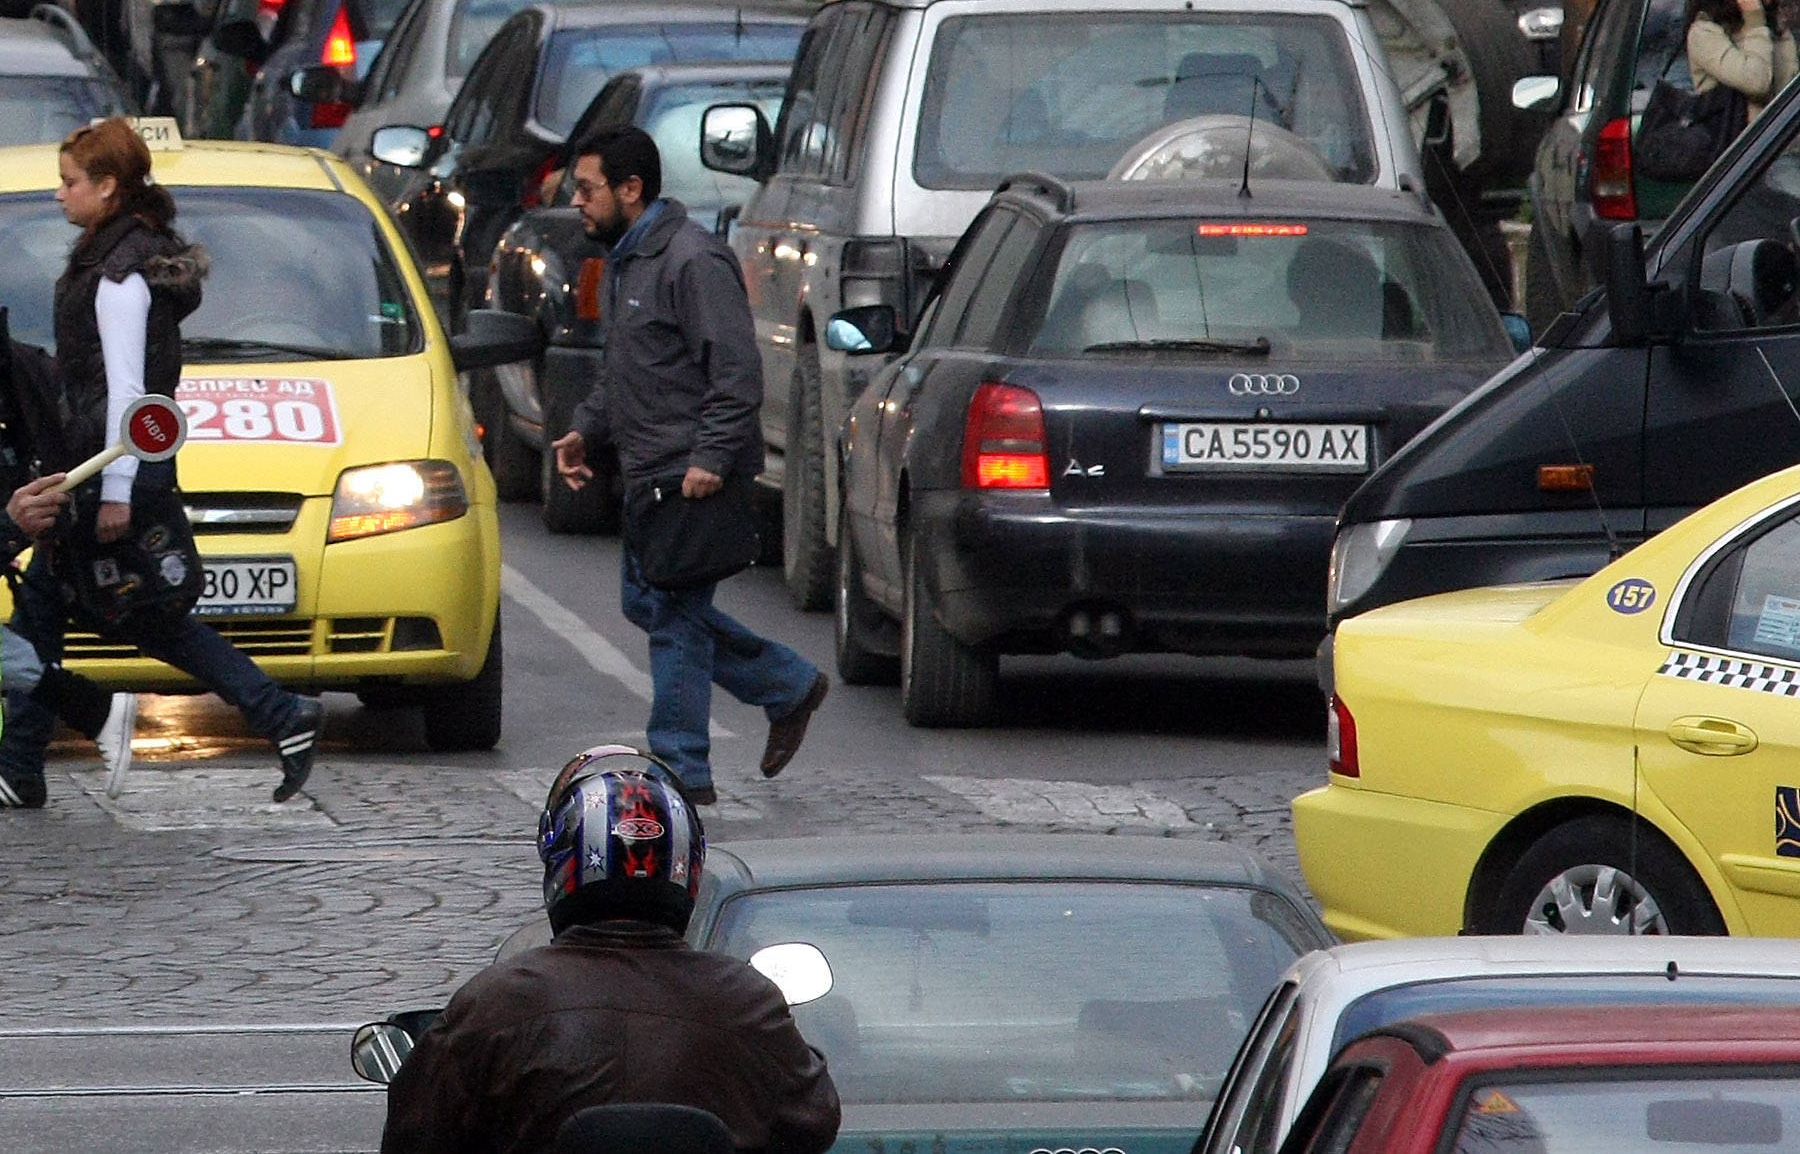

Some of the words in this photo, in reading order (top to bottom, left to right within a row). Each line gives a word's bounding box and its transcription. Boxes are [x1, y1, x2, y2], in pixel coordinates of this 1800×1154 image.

[279, 380, 315, 395] АД
[141, 414, 166, 442] МВР
[176, 399, 325, 440] 280
[1185, 428, 1225, 459] CA
[1233, 429, 1311, 459] 5590
[1319, 429, 1359, 460] AX
[1613, 584, 1654, 608] 157
